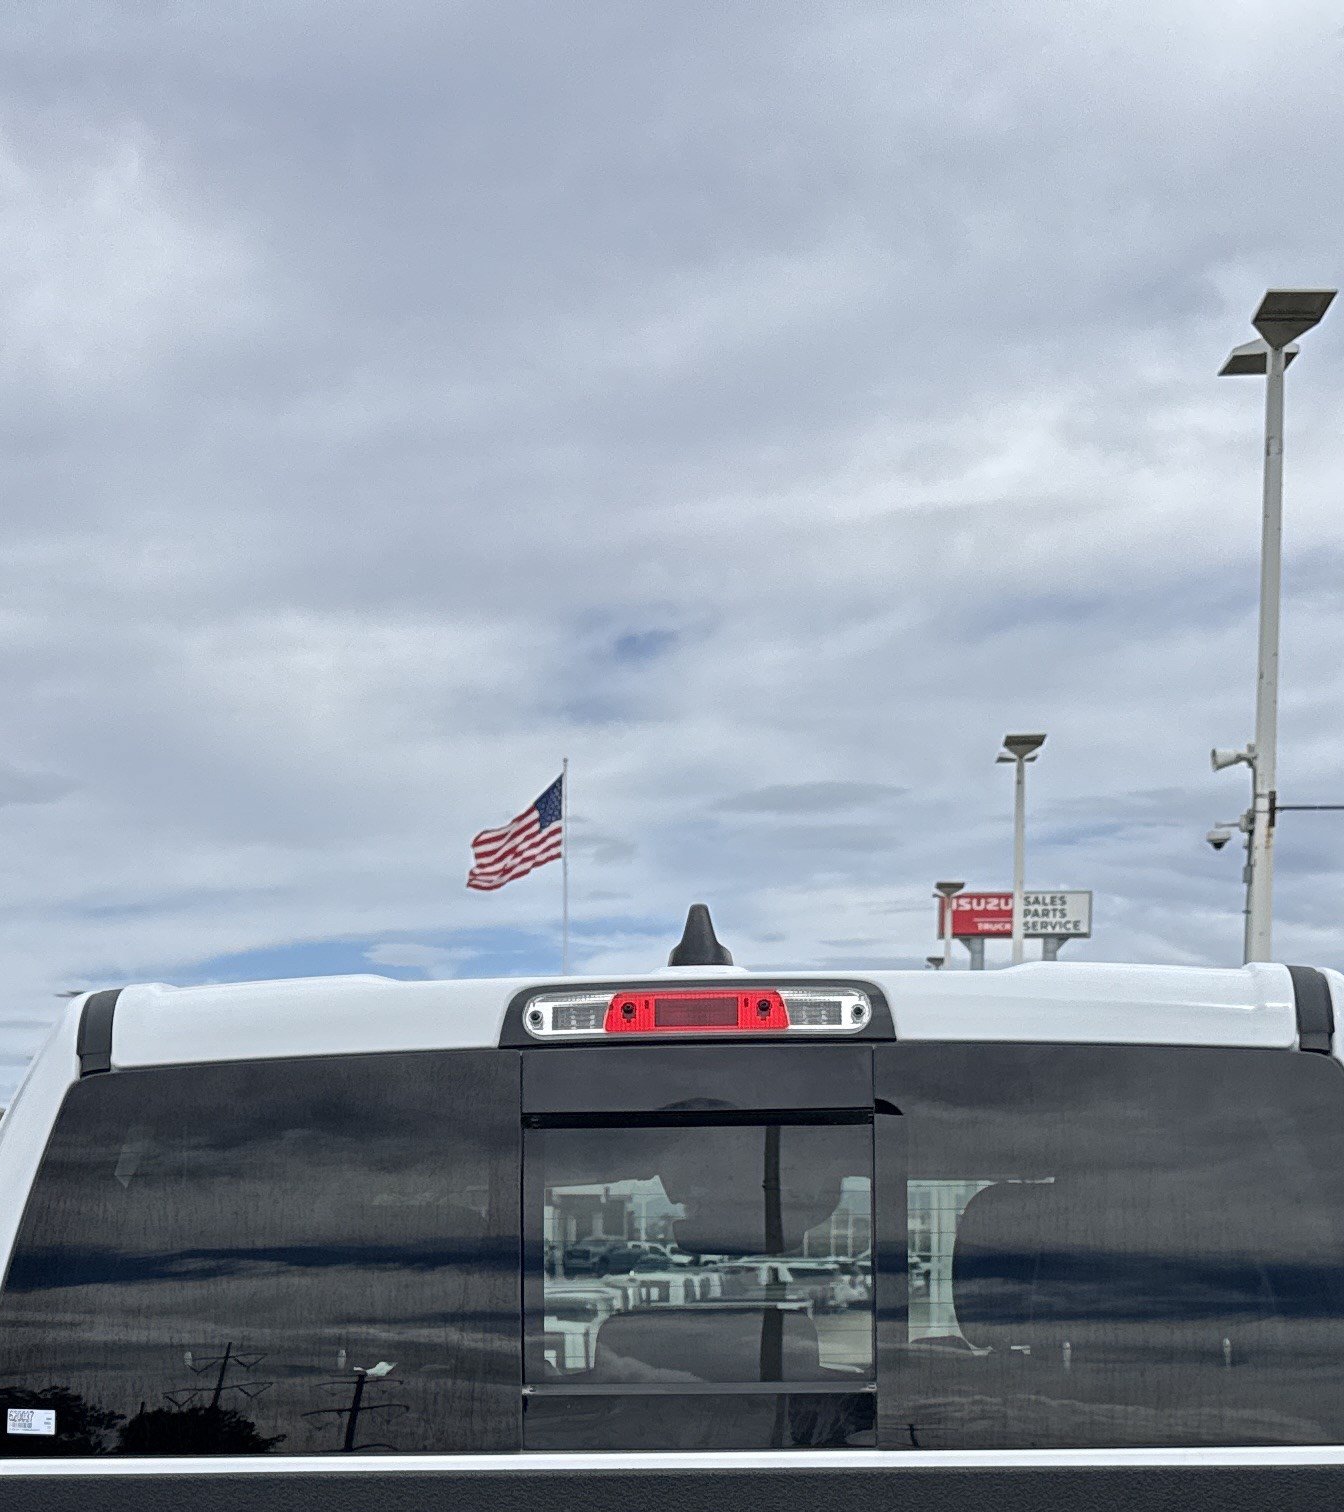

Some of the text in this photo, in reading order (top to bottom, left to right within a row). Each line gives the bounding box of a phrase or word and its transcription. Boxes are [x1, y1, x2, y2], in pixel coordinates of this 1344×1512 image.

[951, 897, 1013, 911] ISUZU
[1023, 895, 1067, 906] SALES
[1023, 907, 1067, 918] PARTS
[1022, 920, 1081, 931] SERVICE
